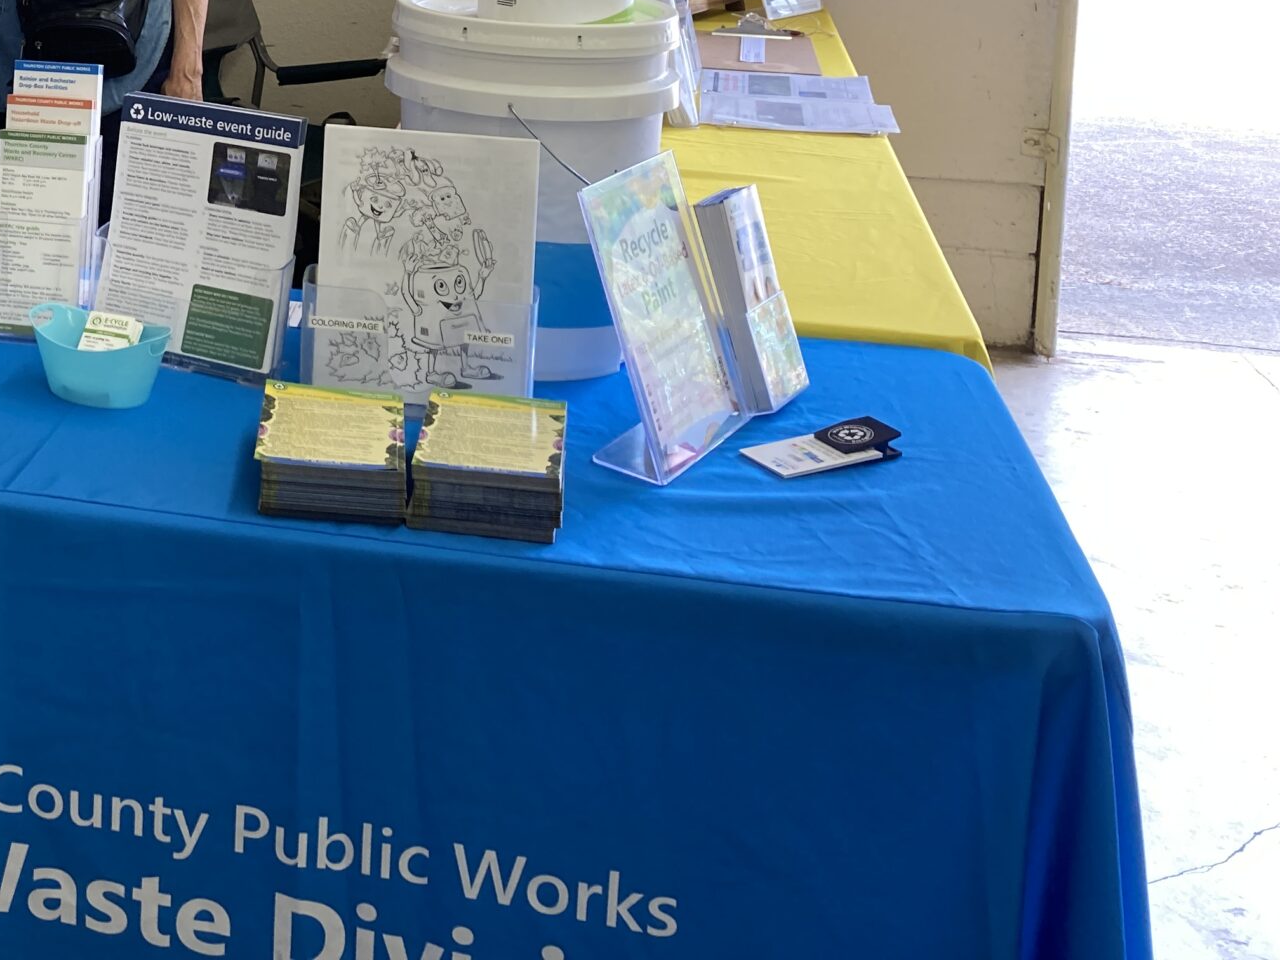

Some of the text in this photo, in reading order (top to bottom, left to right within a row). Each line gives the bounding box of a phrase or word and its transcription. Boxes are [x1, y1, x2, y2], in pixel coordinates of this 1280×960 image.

[147, 107, 292, 142] Low-waste event guide
[619, 219, 669, 264] Recycle
[641, 277, 677, 315] Paint
[311, 318, 379, 331] COLORING PAGE
[467, 333, 512, 345] TAKE ONE!
[233, 803, 430, 886] Public
[453, 841, 679, 939] Works
